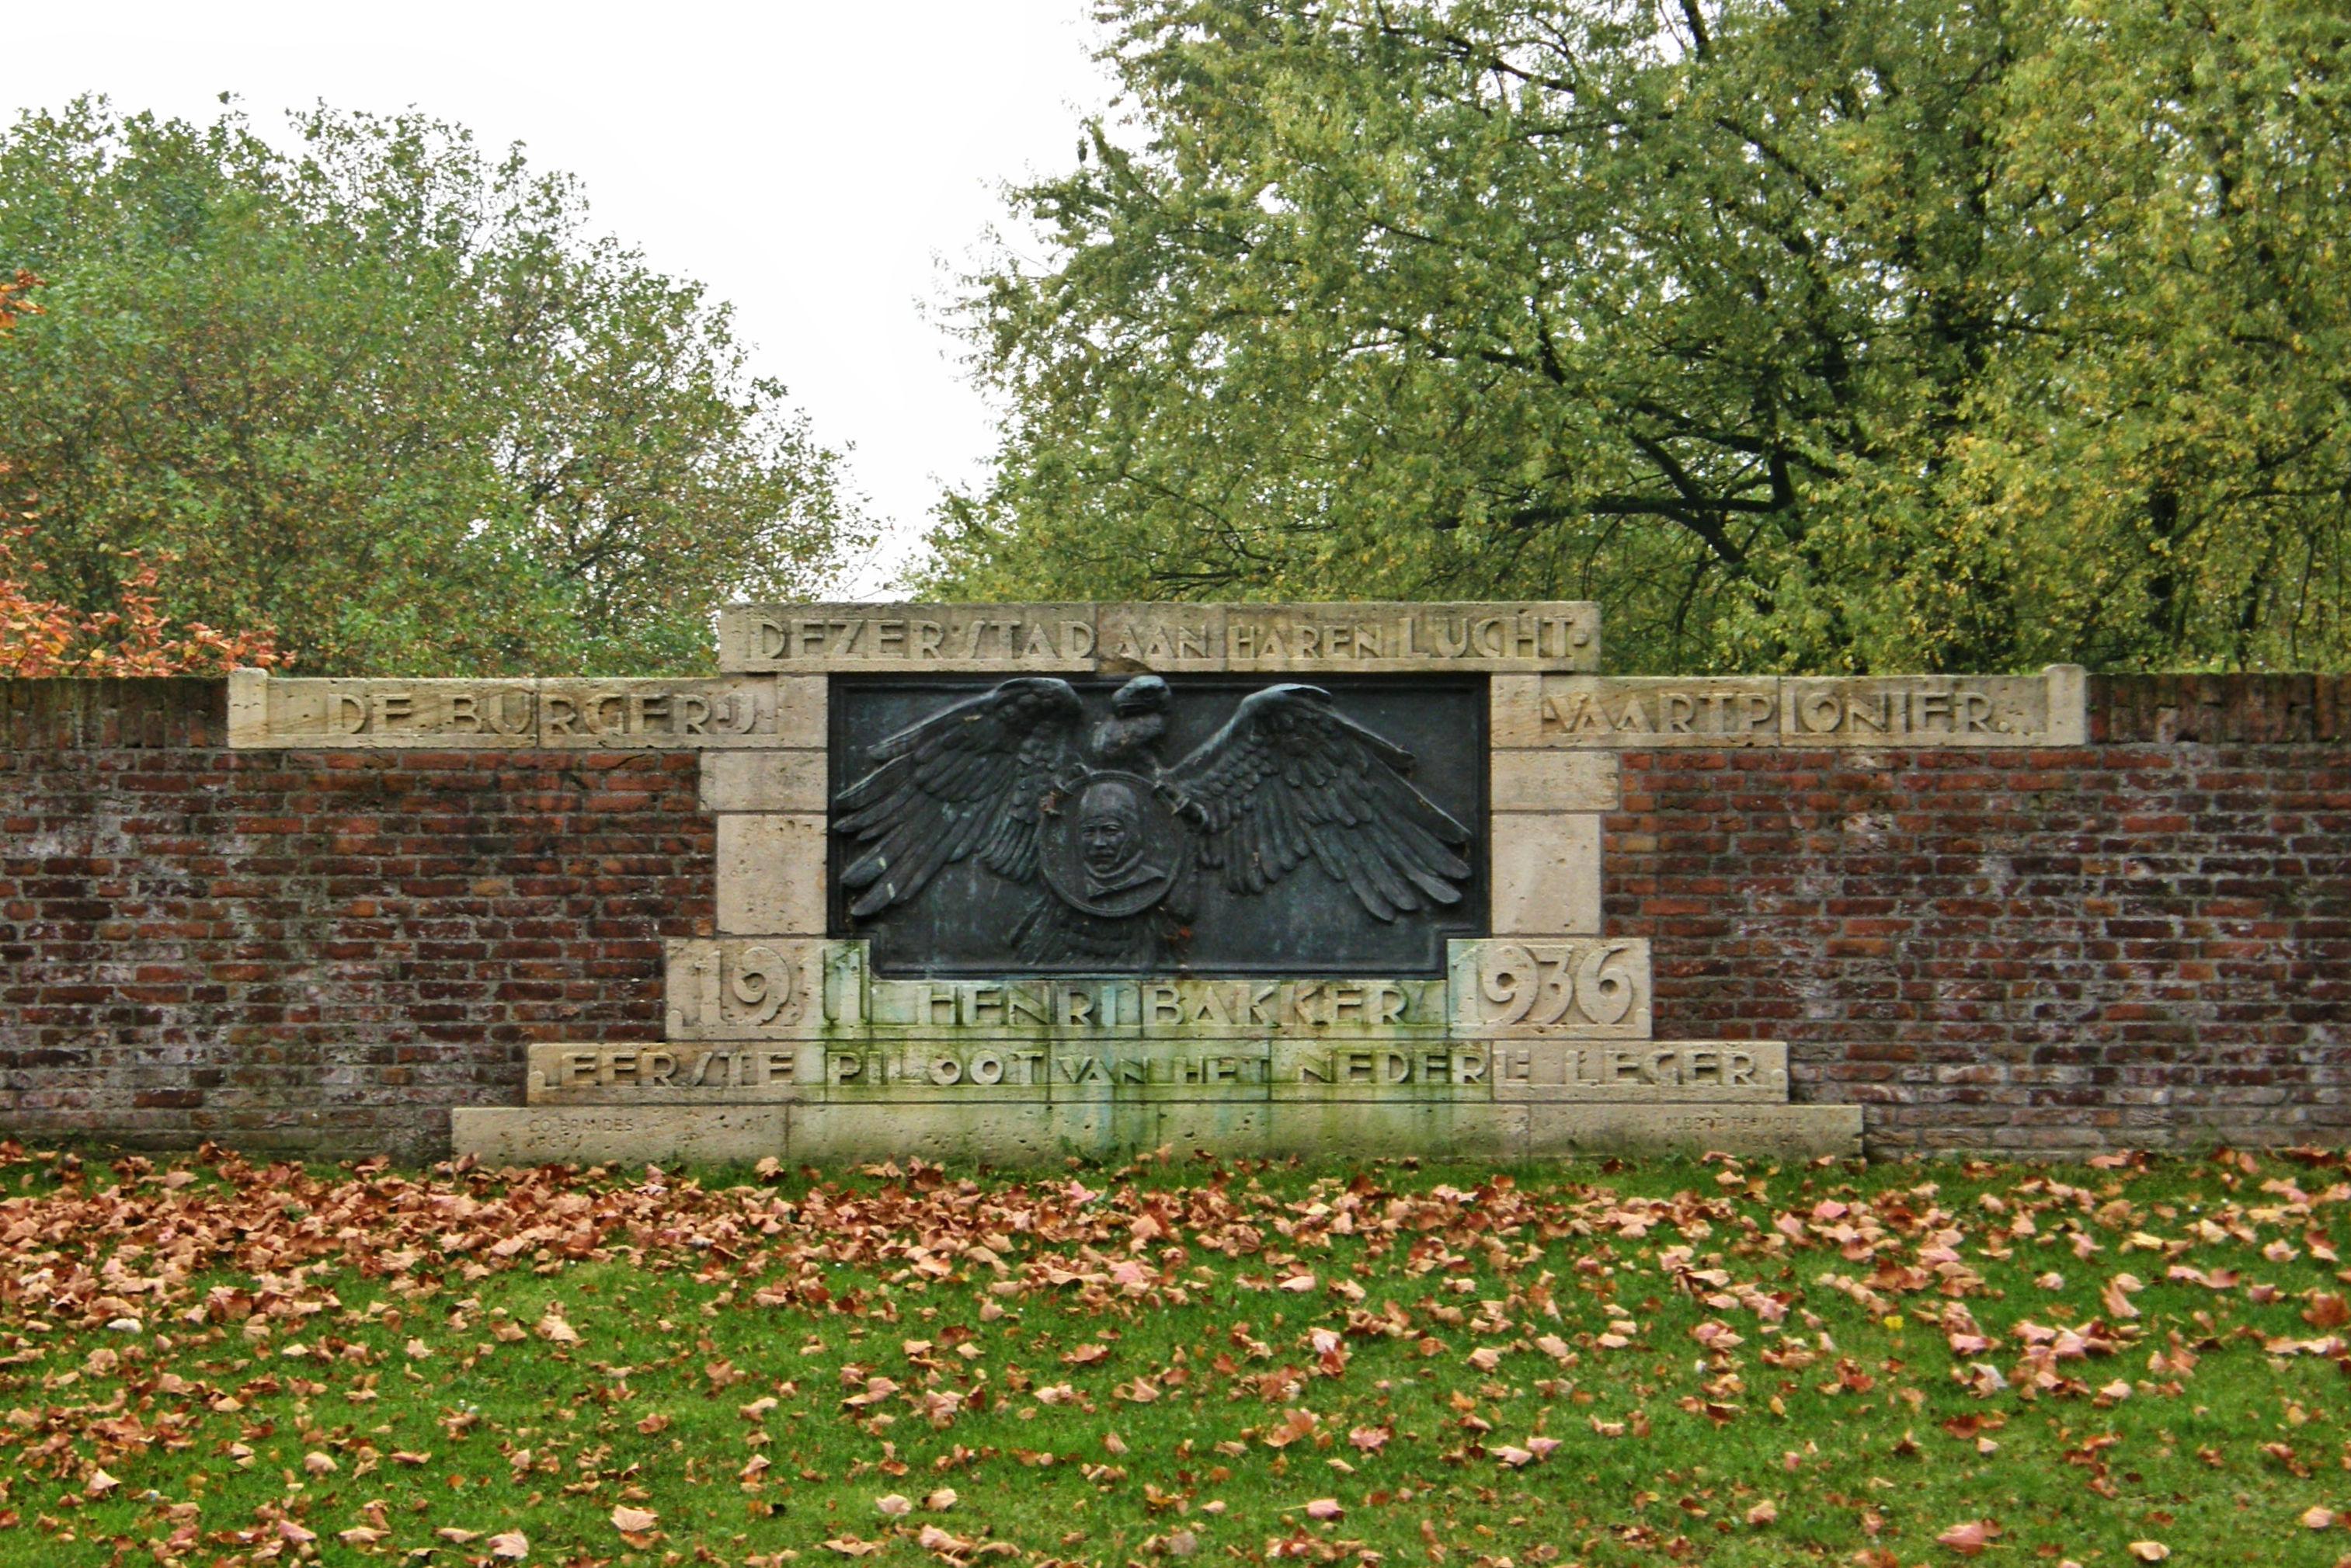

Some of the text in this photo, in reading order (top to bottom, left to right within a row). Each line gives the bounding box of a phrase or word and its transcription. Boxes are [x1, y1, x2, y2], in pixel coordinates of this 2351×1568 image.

[749, 618, 944, 659] DEZER
[966, 620, 1096, 659] STAD
[1117, 622, 1208, 659] AAN
[1229, 622, 1382, 659] HAREN
[327, 694, 412, 735] DE
[693, 946, 861, 1025] 1911
[1451, 944, 1632, 1025] 1936
[917, 985, 1411, 1026] HENRI BAKKER
[562, 1052, 795, 1087] EERSTE
[828, 1051, 1045, 1087] PILOOT
[1058, 1055, 1149, 1087] VAN
[1177, 1056, 1271, 1086] HET
[1565, 1051, 1758, 1086] LEGER
